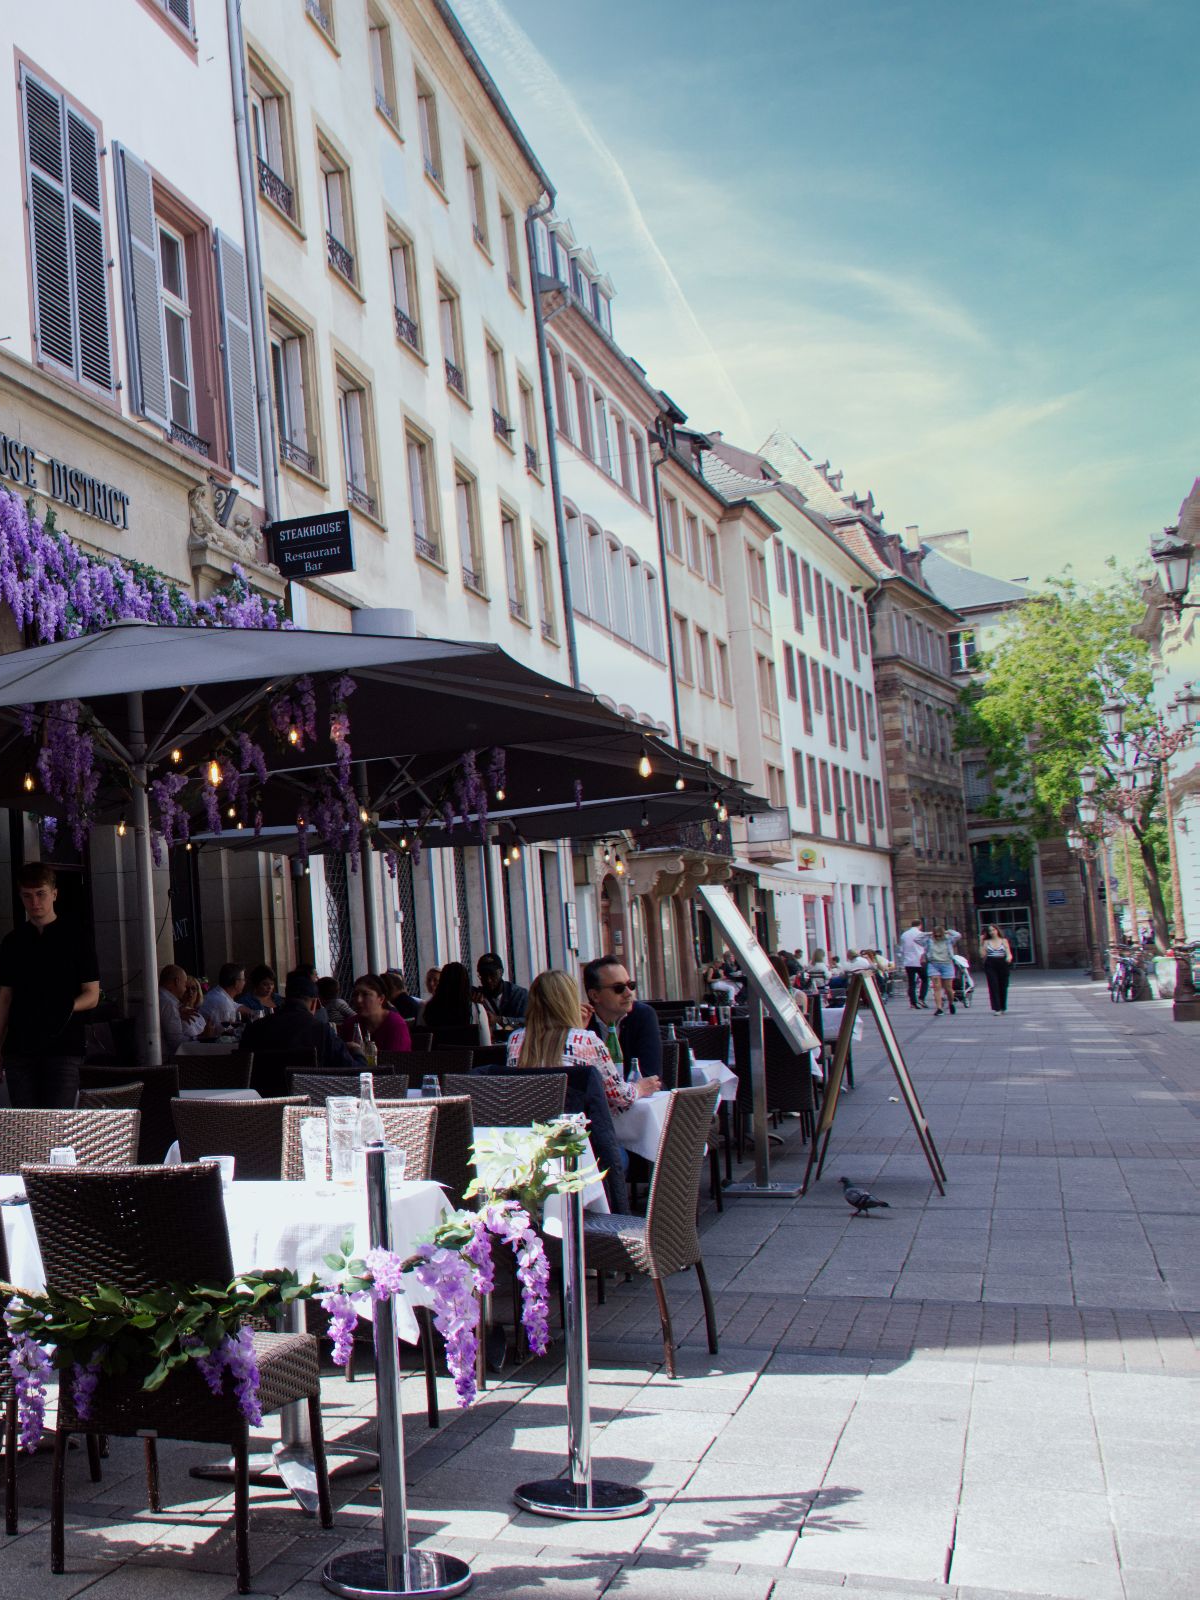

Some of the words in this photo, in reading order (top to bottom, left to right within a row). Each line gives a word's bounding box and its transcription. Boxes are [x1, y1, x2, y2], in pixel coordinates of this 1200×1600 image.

[50, 458, 130, 529] DISTRICT
[279, 522, 342, 541] STEAKHOUSE
[284, 546, 341, 562] Restaurant
[305, 562, 322, 572] Bar
[984, 888, 1017, 898] JULES
